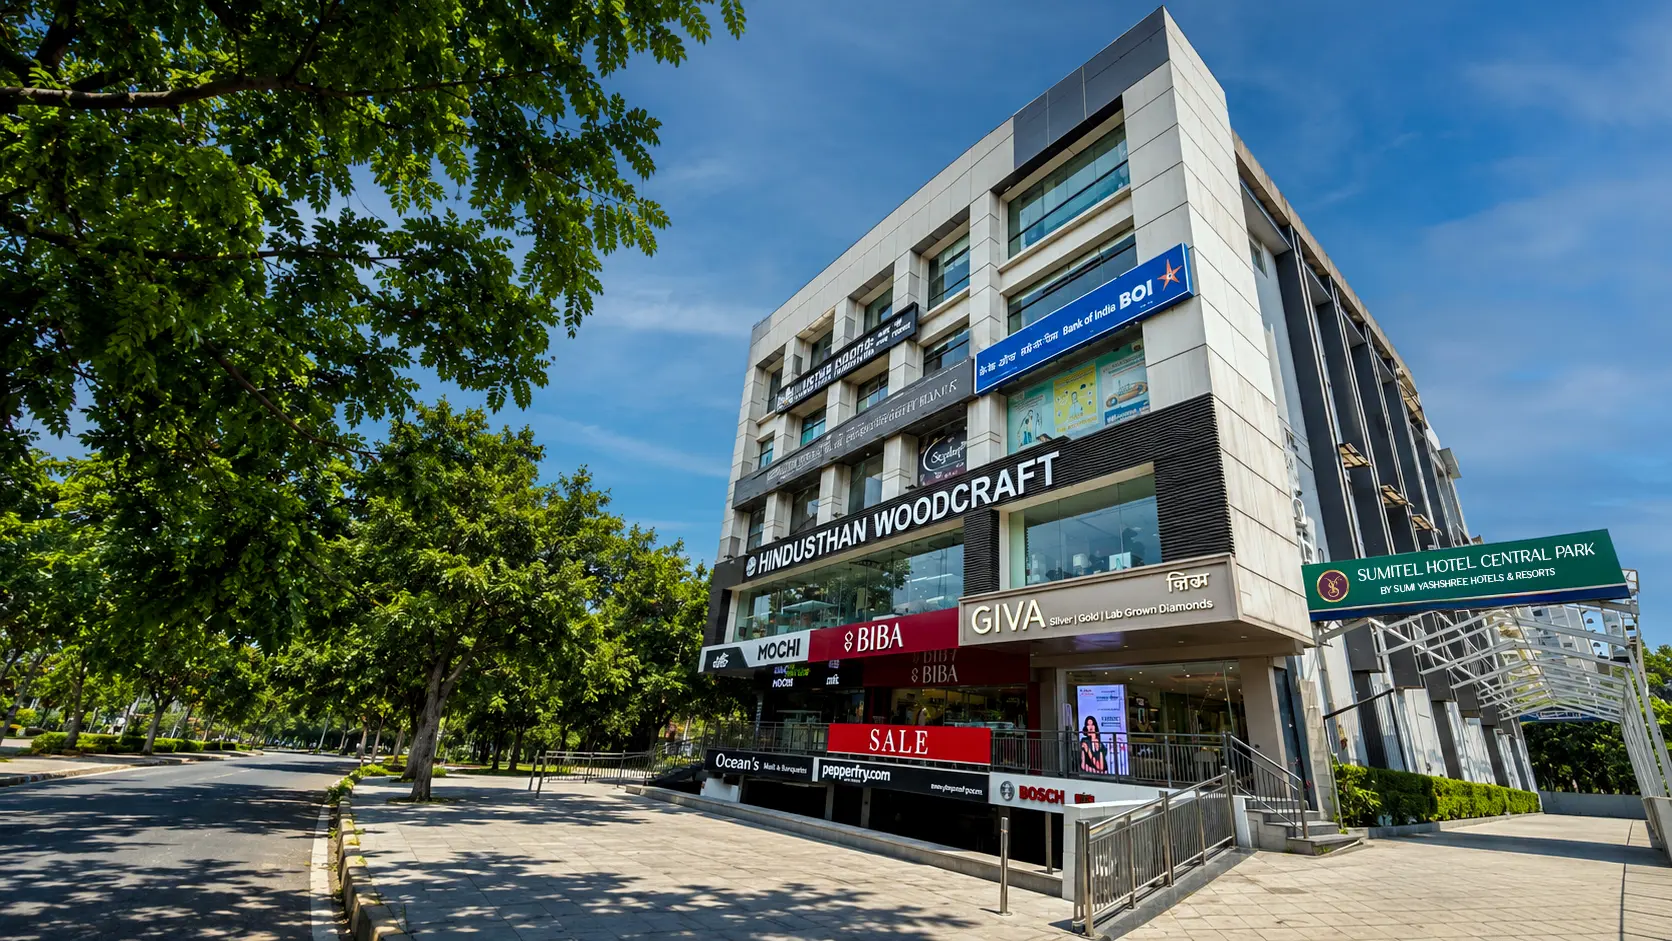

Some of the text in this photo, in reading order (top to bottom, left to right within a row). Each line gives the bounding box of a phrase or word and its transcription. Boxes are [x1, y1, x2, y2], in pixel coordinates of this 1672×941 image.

[1119, 280, 1153, 310] BOI
[1062, 303, 1116, 335] Bank of India
[758, 517, 867, 574] HINDUSTHAN
[874, 451, 1060, 537] WOODCRAFT
[1357, 542, 1596, 582] SUMITEL HOTEL CENTRAL PARK
[1380, 568, 1556, 595] BY SUMI YASHSHREE HOTELS & RESORTS
[971, 599, 1046, 635] GIVA
[1050, 616, 1073, 627] Silver
[1078, 612, 1099, 624] Gold
[1105, 608, 1123, 620] Lab
[1124, 604, 1157, 617] Grown
[1159, 599, 1213, 613] Diamonds
[757, 638, 800, 661] MOCHI
[857, 622, 904, 652] BIBA
[922, 664, 958, 684] BIBA
[869, 728, 929, 755] SALE
[715, 753, 760, 771] Ocean's
[822, 765, 891, 783] pepperfry.com
[1019, 785, 1065, 804] BOSCH
